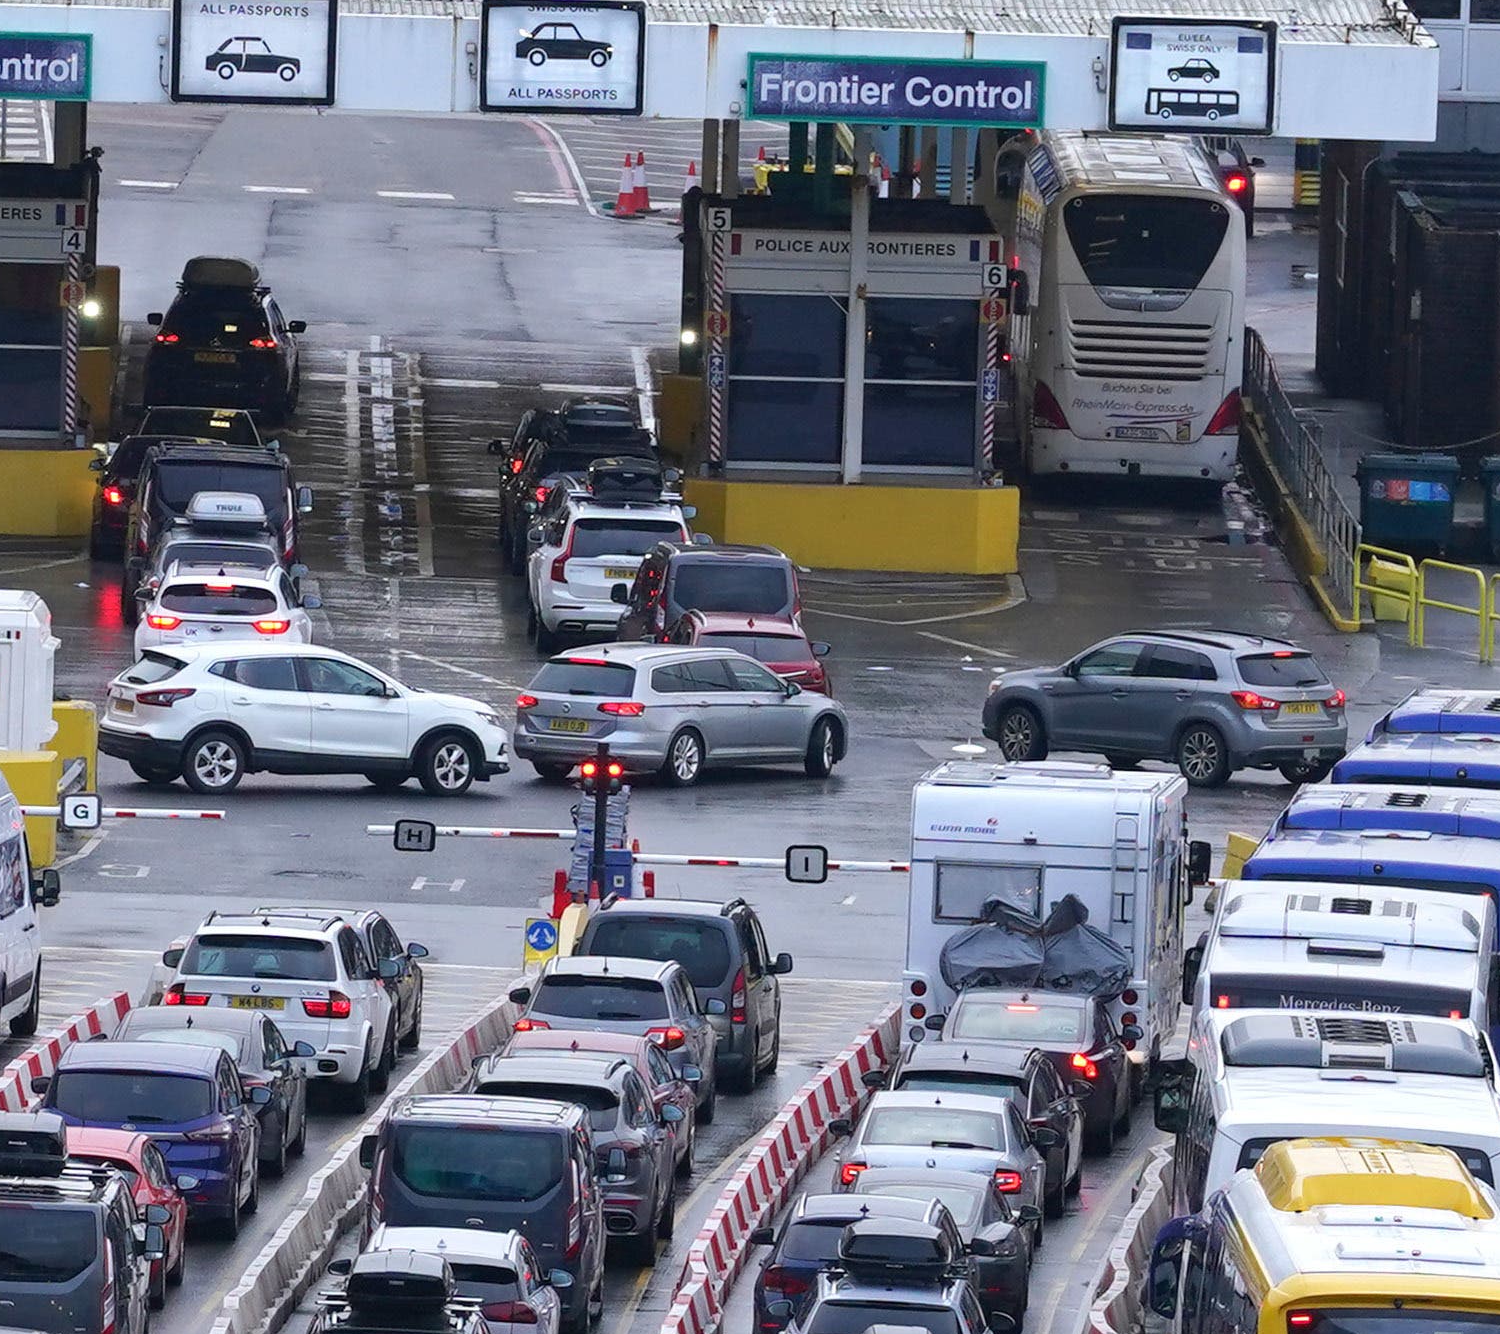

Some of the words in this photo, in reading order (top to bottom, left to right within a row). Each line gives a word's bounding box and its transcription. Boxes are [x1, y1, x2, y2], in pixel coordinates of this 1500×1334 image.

[199, 3, 226, 15] ALL
[229, 4, 310, 18] PASSPORTS
[1178, 33, 1212, 43] EU/EEA
[1166, 43, 1194, 54] SWISS
[1195, 44, 1222, 54] ONLY
[508, 87, 533, 99] ALL
[537, 88, 618, 101] PASSPORTS
[760, 72, 896, 105] Frontier
[904, 76, 1033, 110] Control
[712, 210, 727, 229] 5
[66, 232, 82, 252] 4
[755, 239, 813, 253] POLICE
[819, 240, 851, 255] AUX
[866, 241, 957, 257] RONTIERES
[987, 266, 1002, 285] 6
[185, 627, 198, 637] UK
[73, 803, 89, 820] G
[406, 829, 424, 843] H
[1279, 993, 1403, 1012] Mercedes-Benz
